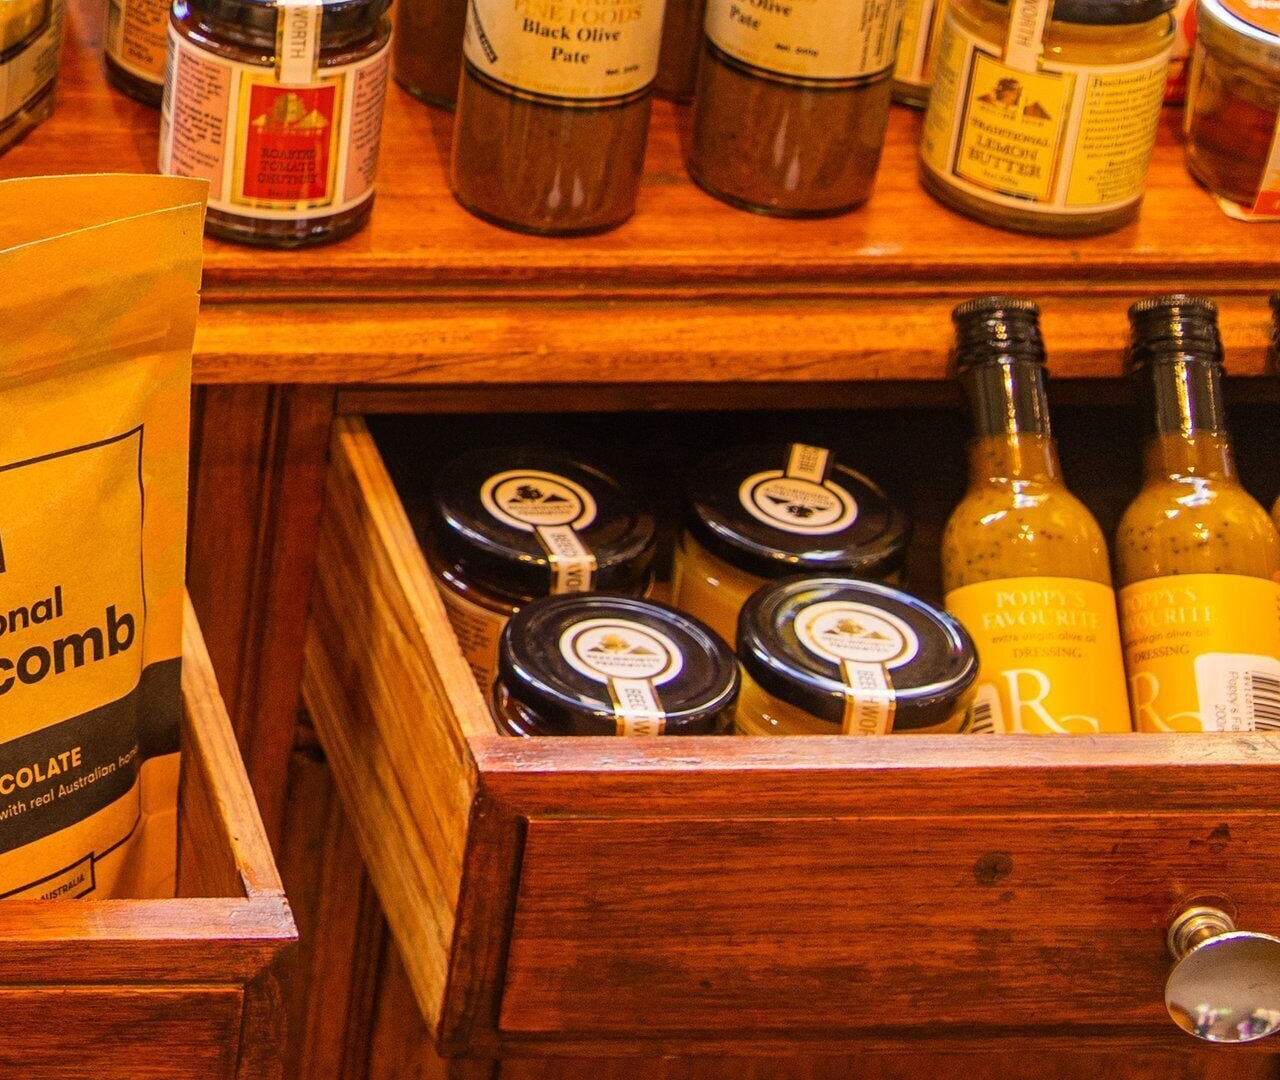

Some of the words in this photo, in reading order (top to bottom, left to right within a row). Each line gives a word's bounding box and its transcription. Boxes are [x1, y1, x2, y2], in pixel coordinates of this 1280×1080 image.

[522, 17, 571, 41] Black
[576, 27, 621, 43] Olive
[550, 46, 590, 64] Pate
[1057, 631, 1083, 642] olive
[1165, 630, 1193, 640] olive
[1012, 646, 1083, 659] DRESSING
[1133, 644, 1191, 664] DRESSING
[29, 789, 55, 809] real
[57, 762, 117, 797] Australian
